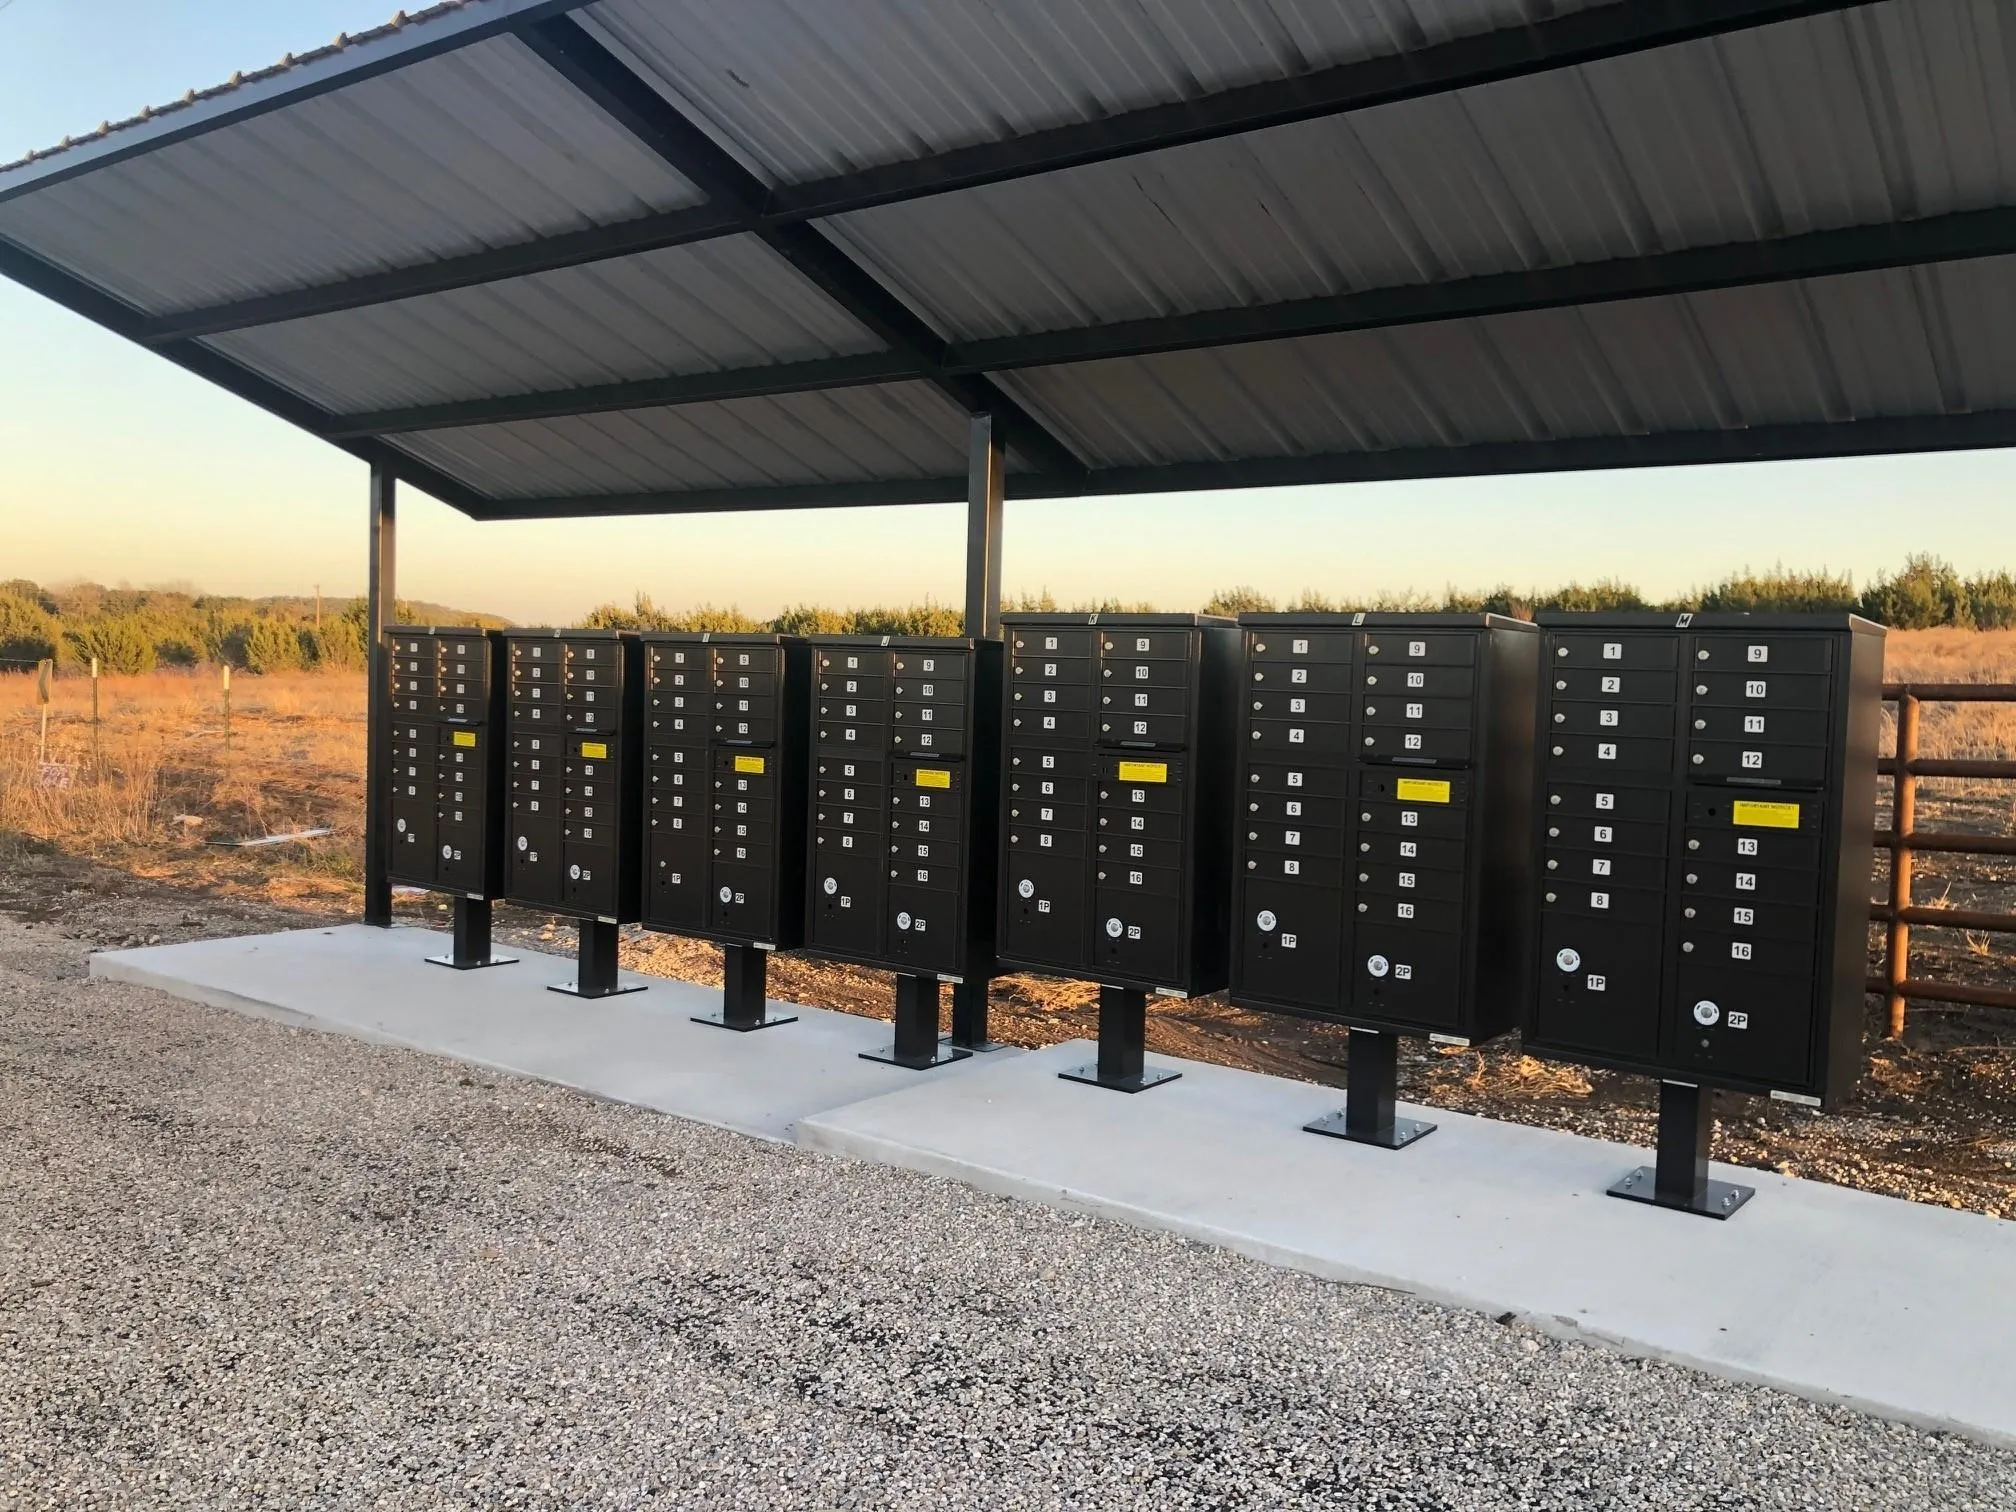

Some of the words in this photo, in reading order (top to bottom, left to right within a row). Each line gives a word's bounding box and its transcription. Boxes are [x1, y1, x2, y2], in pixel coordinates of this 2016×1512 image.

[1414, 644, 1421, 654] 9
[1753, 648, 1762, 660] 9
[1137, 668, 1148, 678] 10
[1296, 671, 1303, 681] 2
[1410, 675, 1422, 685] 10
[1606, 679, 1615, 691] 2
[1748, 683, 1764, 696] 10
[1137, 695, 1146, 705] 11
[1295, 700, 1301, 710] 3
[1409, 706, 1421, 716] 11
[1605, 712, 1613, 724] 3
[1135, 722, 1146, 733] 12
[1747, 718, 1762, 731] 11
[1293, 731, 1300, 741] 4
[1407, 736, 1420, 747] 12
[1602, 746, 1611, 757] 4
[1744, 754, 1761, 766] 12
[1292, 774, 1298, 784] 5
[1133, 791, 1144, 801] 13
[1600, 795, 1609, 807] 5
[1290, 803, 1297, 814] 6
[1132, 818, 1143, 828] 14
[1403, 813, 1416, 824] 13
[1289, 832, 1296, 842] 7
[1599, 828, 1608, 840] 6
[1131, 846, 1142, 856] 15
[1402, 844, 1415, 855] 14
[1740, 840, 1756, 853] 13
[1288, 862, 1295, 872] 8
[1598, 861, 1606, 873] 7
[1130, 873, 1142, 883] 16
[1400, 875, 1414, 886] 15
[1737, 875, 1754, 888] 14
[1596, 894, 1604, 906] 8
[1039, 901, 1050, 911] 1P
[1399, 905, 1412, 916] 16
[1735, 910, 1752, 923] 15
[1128, 927, 1141, 938] 2P
[1282, 935, 1296, 946] 1P
[1733, 944, 1750, 958] 16
[1396, 966, 1411, 977] 2P
[1588, 976, 1605, 988] 1P
[1728, 1013, 1747, 1026] 2P
